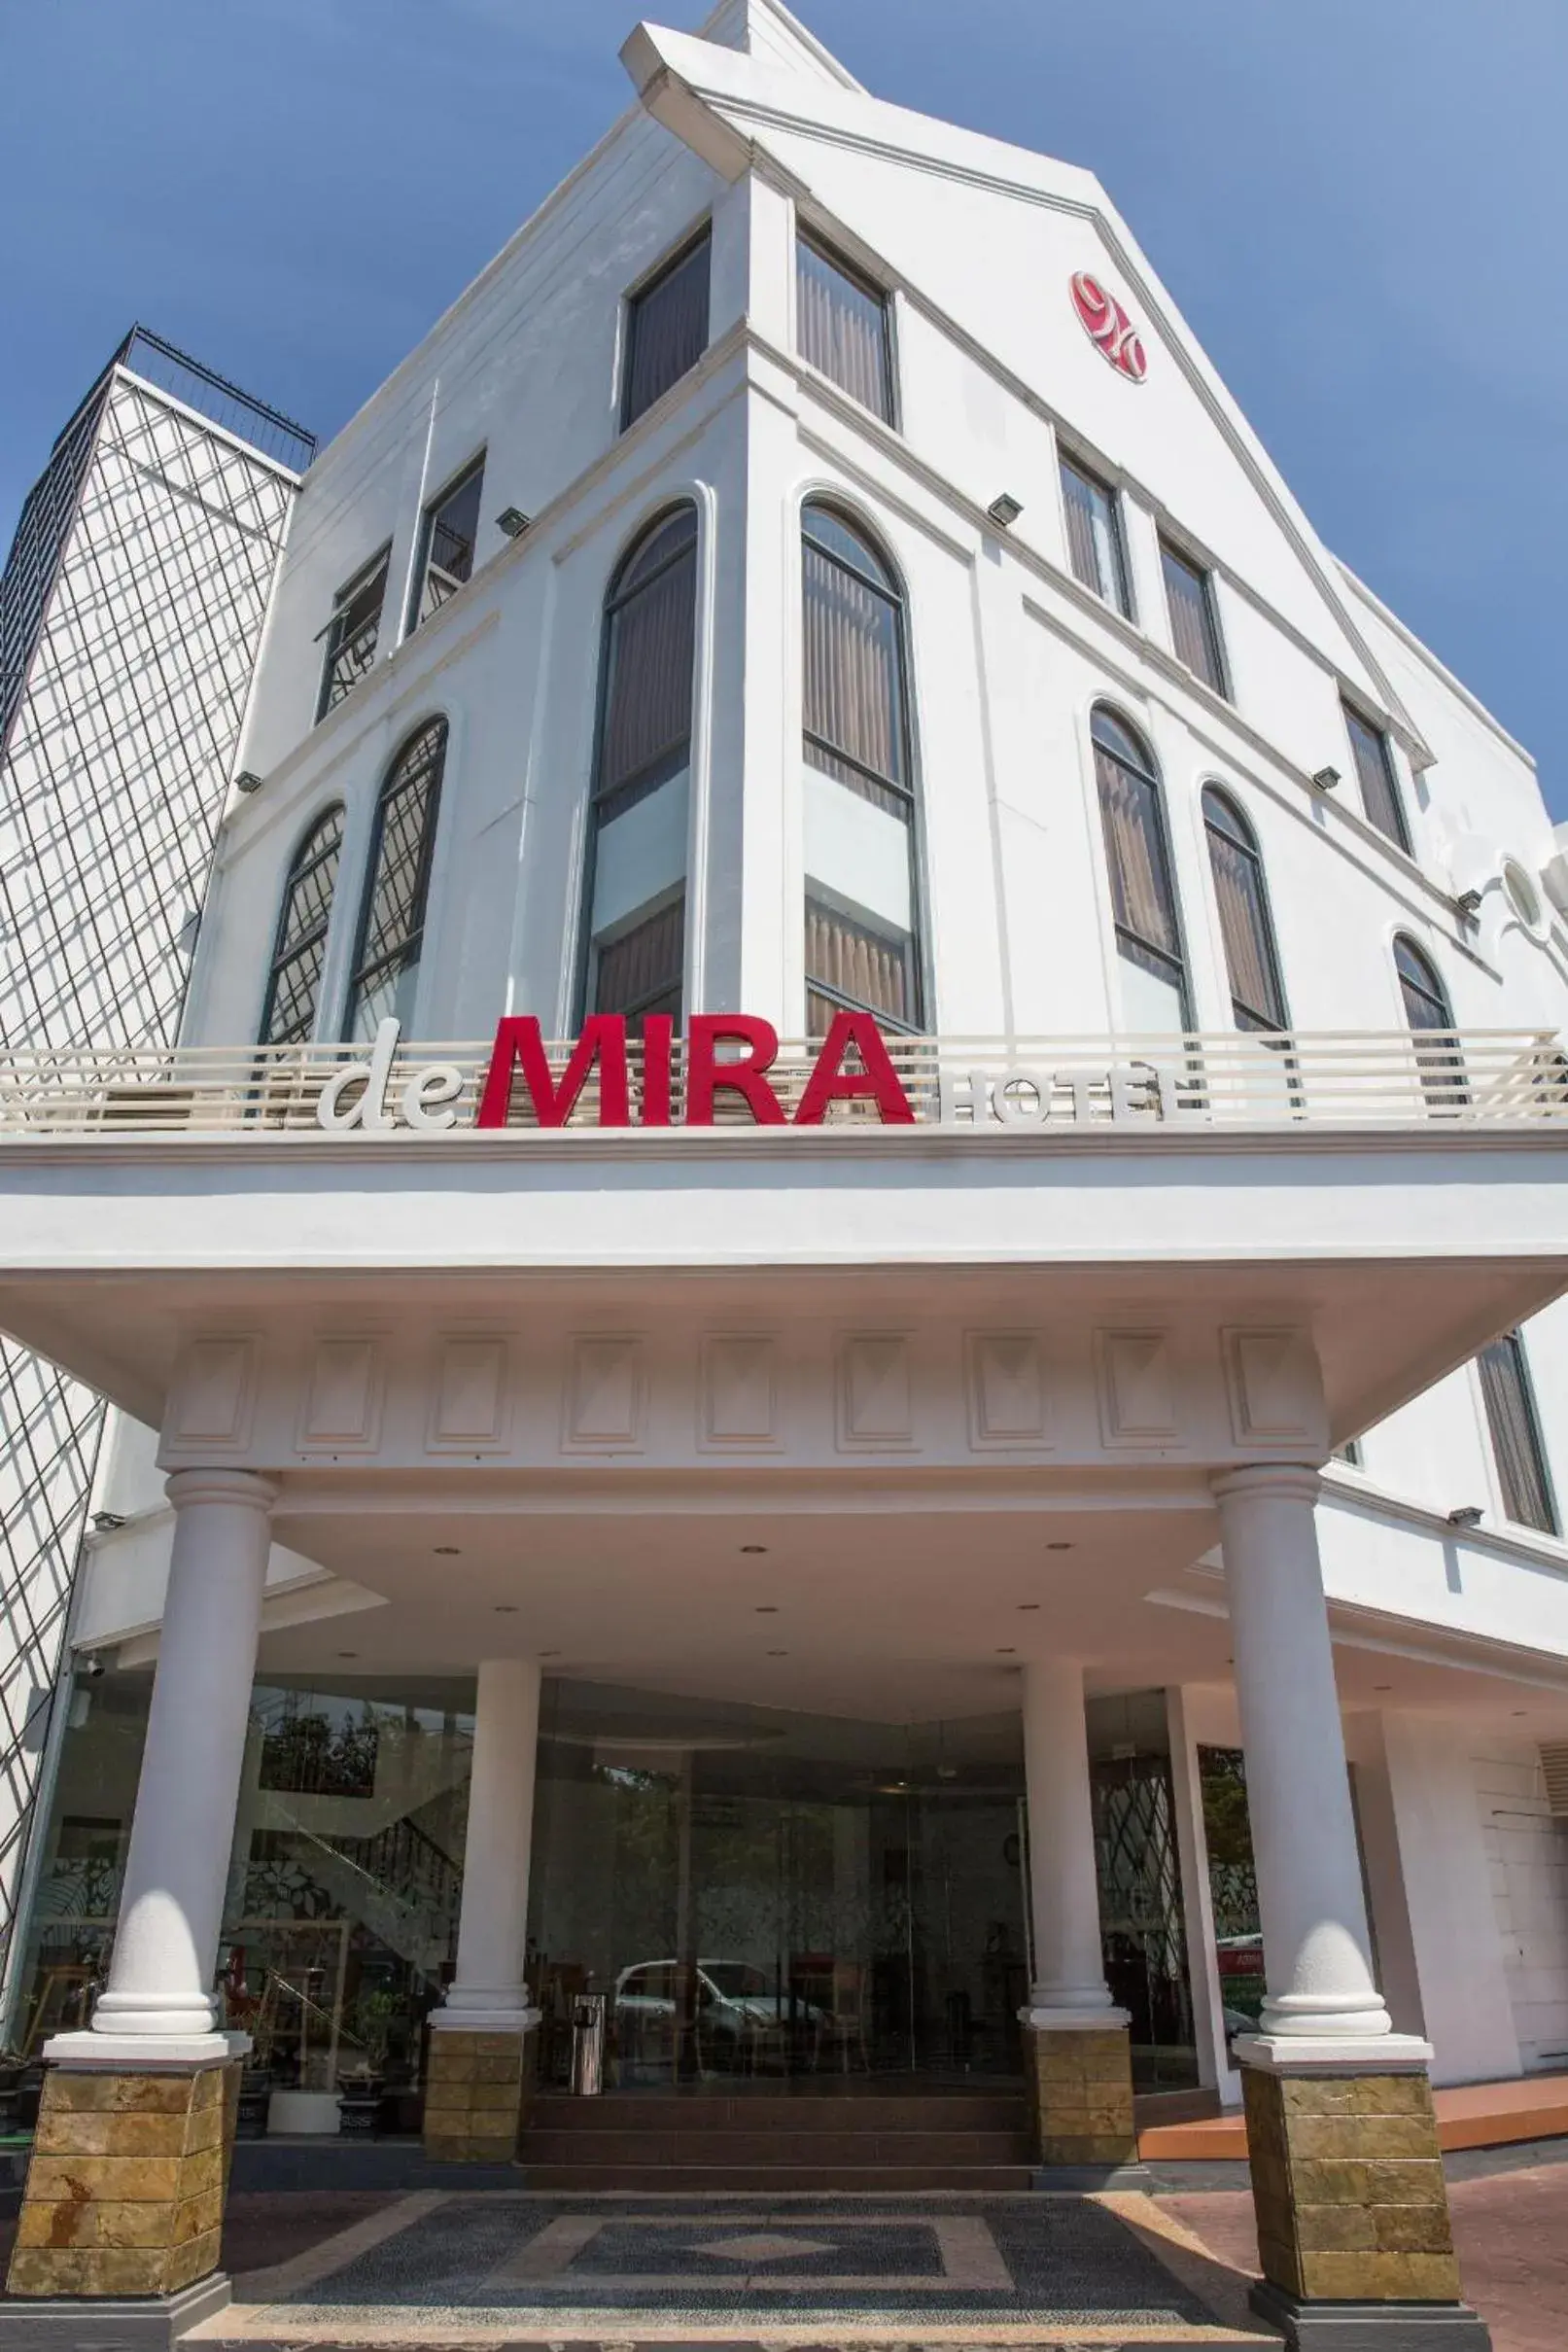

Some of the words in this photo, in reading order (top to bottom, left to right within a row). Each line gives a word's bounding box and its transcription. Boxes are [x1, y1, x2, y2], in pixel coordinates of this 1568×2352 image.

[317, 1017, 464, 1129] de
[477, 1012, 916, 1128] MIRA
[938, 1065, 1211, 1125] HOTEL
